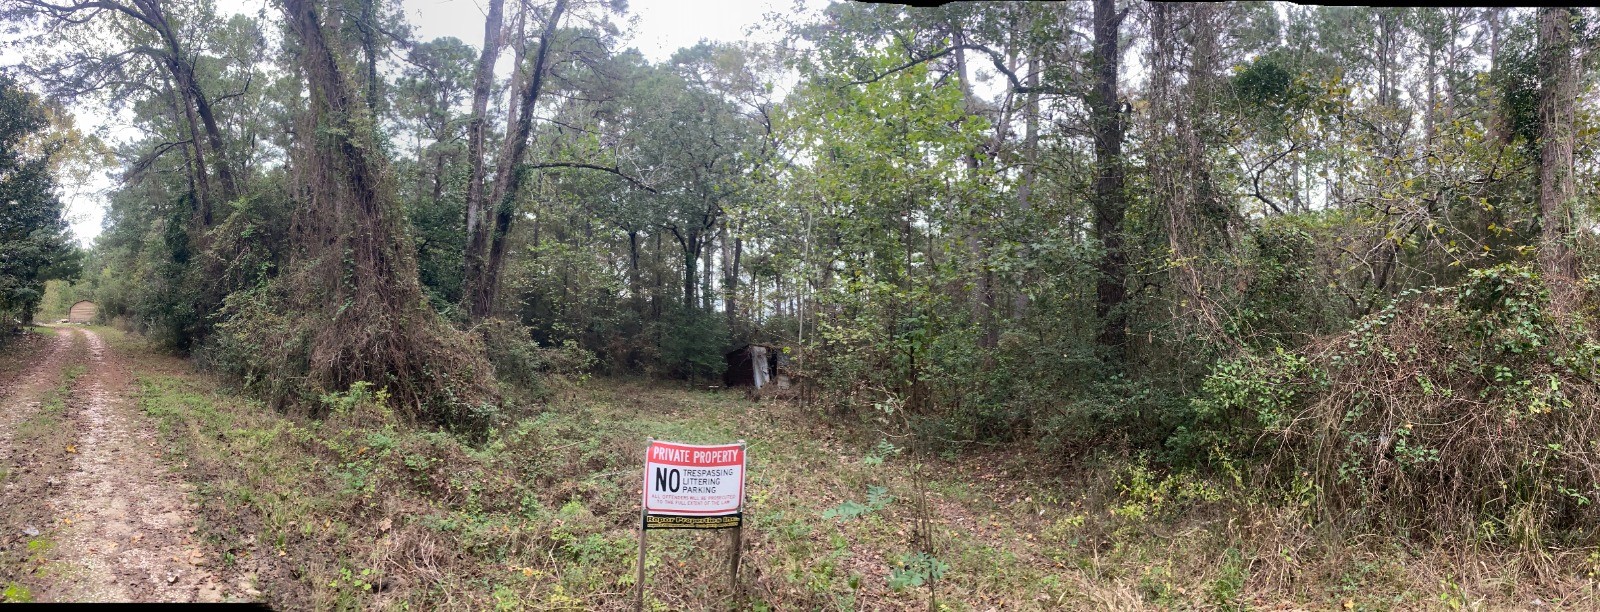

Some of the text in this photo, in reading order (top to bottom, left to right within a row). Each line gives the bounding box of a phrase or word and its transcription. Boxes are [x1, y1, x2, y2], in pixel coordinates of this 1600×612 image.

[653, 446, 738, 464] PRIVATE PROPERTY
[683, 468, 733, 477] TRESPASSING
[655, 467, 681, 493] NO
[682, 477, 721, 486] LITTERING
[682, 486, 717, 494] PARKING
